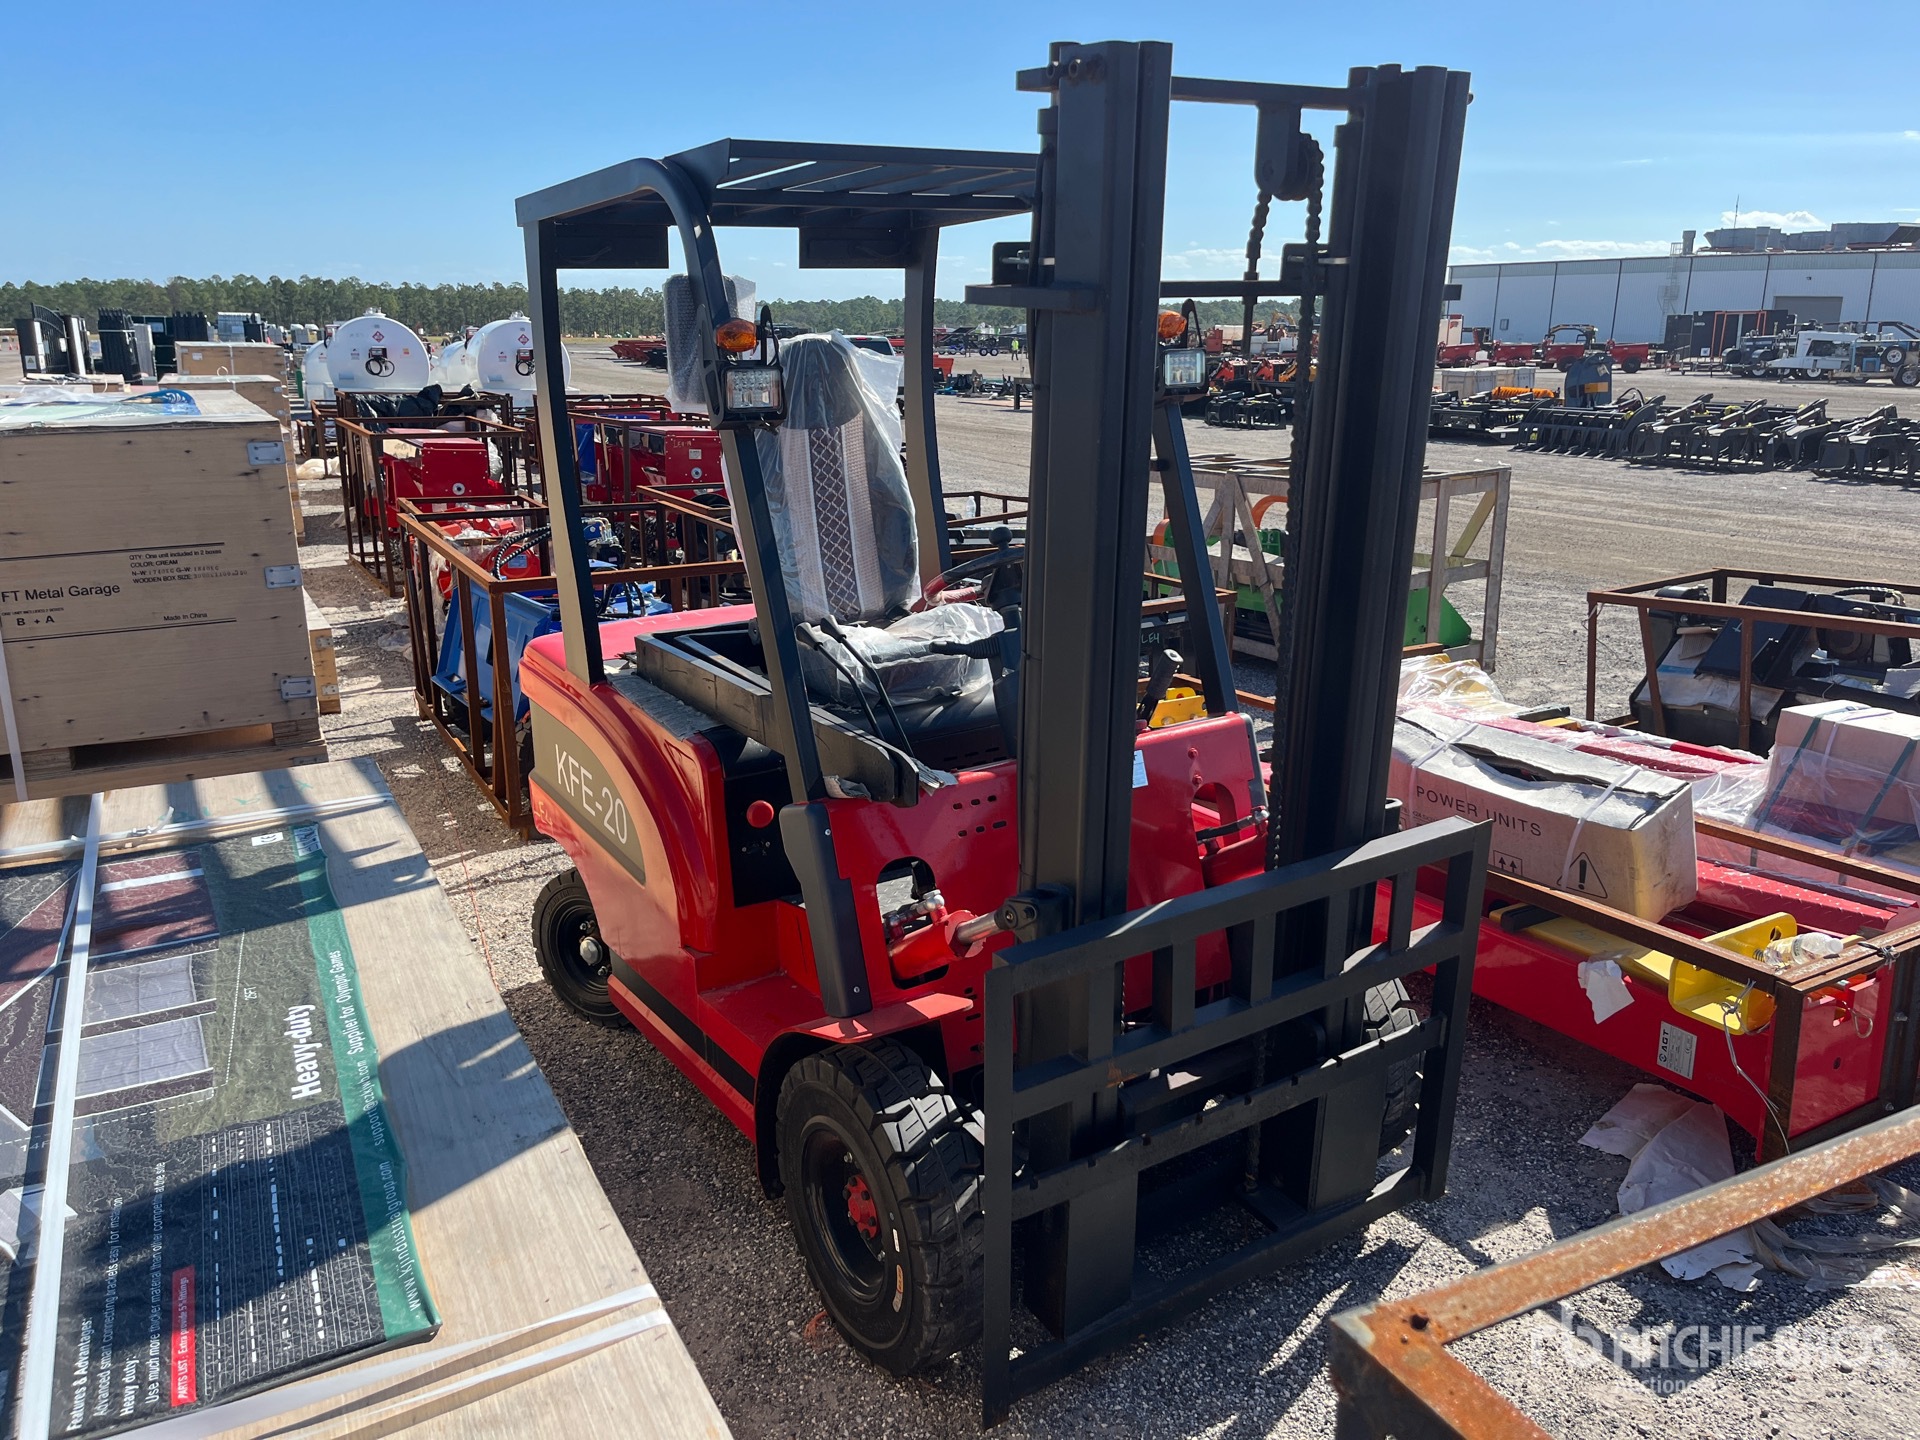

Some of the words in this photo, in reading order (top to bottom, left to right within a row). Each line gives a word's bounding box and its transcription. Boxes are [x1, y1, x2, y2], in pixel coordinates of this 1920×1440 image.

[1, 590, 20, 602] FT
[25, 586, 64, 600] Metal
[68, 584, 120, 596] Garage
[16, 618, 25, 626] B
[45, 615, 55, 624] A
[555, 744, 627, 844] KFE-20
[1416, 785, 1478, 817] POWER
[1486, 808, 1542, 837] UNITS
[328, 950, 346, 974] Games
[332, 973, 354, 1004] Olympic
[339, 1004, 355, 1018] for
[342, 1018, 365, 1055] Supplier
[283, 1004, 323, 1100] Heavy-duty
[108, 1230, 120, 1244] for
[151, 1233, 162, 1252] other
[378, 1161, 422, 1312] www.kjindustrialgroup.com
[110, 1245, 122, 1263] easy
[150, 1252, 161, 1270] than
[150, 1272, 161, 1302] material
[178, 1277, 189, 1301] fittings
[103, 1296, 118, 1342] connecting
[178, 1311, 189, 1335] provide
[73, 1317, 95, 1375] Advantages:
[100, 1343, 112, 1370] smart
[149, 1333, 160, 1356] more
[177, 1335, 188, 1354] Extra
[71, 1376, 88, 1386] &
[122, 1356, 139, 1383] duty:
[146, 1358, 160, 1380] much
[93, 1370, 110, 1416] Advanced
[145, 1382, 159, 1403] Use
[177, 1375, 188, 1399] PARTS
[65, 1386, 87, 1431] Features
[120, 1385, 139, 1416] Heavy
